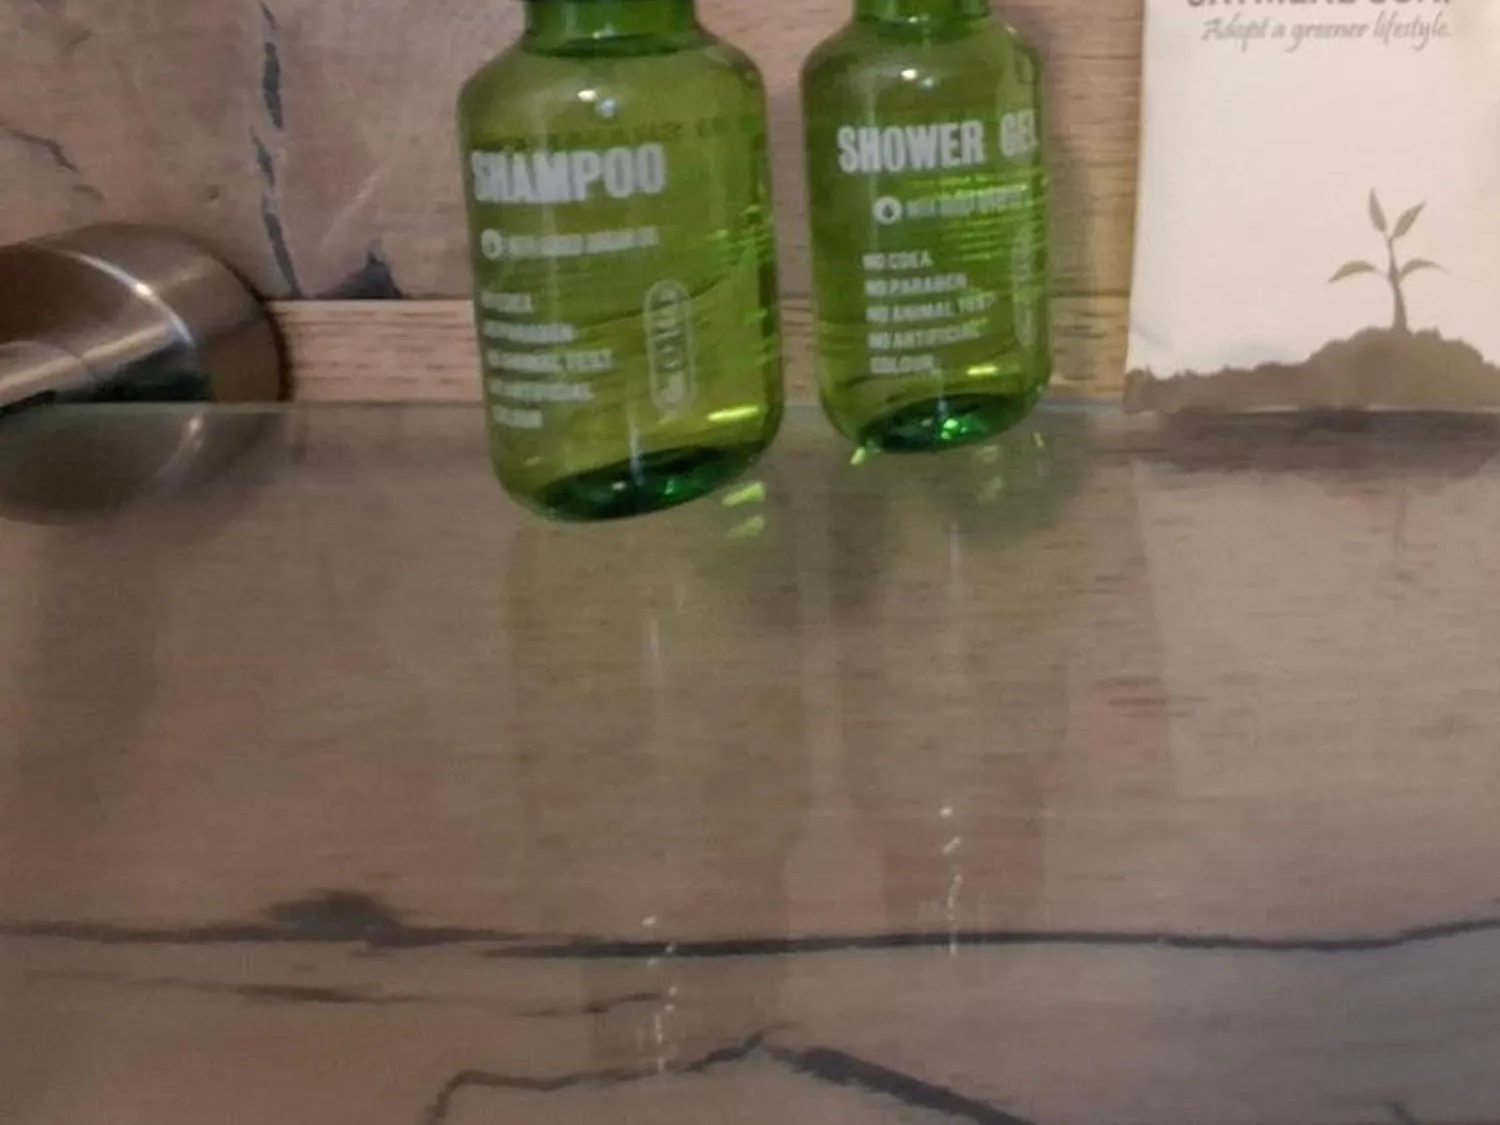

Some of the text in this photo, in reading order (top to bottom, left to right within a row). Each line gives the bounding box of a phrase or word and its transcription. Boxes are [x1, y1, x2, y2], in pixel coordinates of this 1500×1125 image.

[1200, 10, 1455, 53] Adopt a greener lifestyle
[836, 119, 988, 174] SHOWER
